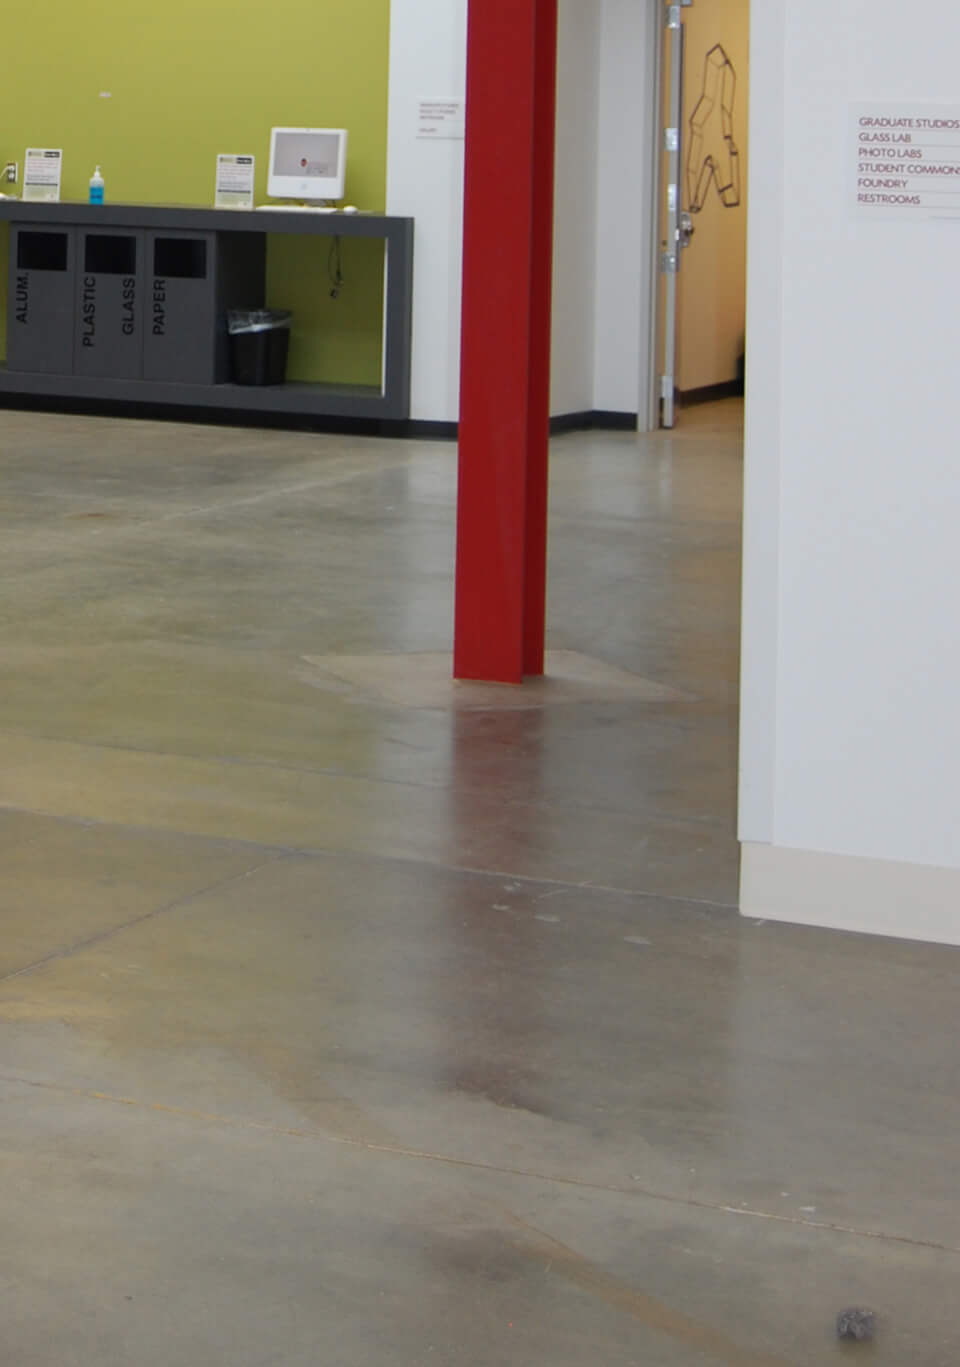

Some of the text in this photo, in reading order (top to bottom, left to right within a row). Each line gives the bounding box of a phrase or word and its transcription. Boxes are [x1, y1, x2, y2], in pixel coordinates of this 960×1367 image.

[859, 117, 960, 129] GRADUATE STUDIOS
[858, 132, 912, 144] GLASS LAB
[858, 147, 922, 159] PHOTO LABS
[858, 163, 905, 173] STUDENT
[858, 178, 908, 188] FOUNDRY
[857, 193, 921, 205] RESTROOMS
[15, 272, 30, 325] ALUM.
[82, 276, 97, 348] PLASTIC
[121, 277, 136, 336] GLASS
[151, 279, 166, 336] PAPER
